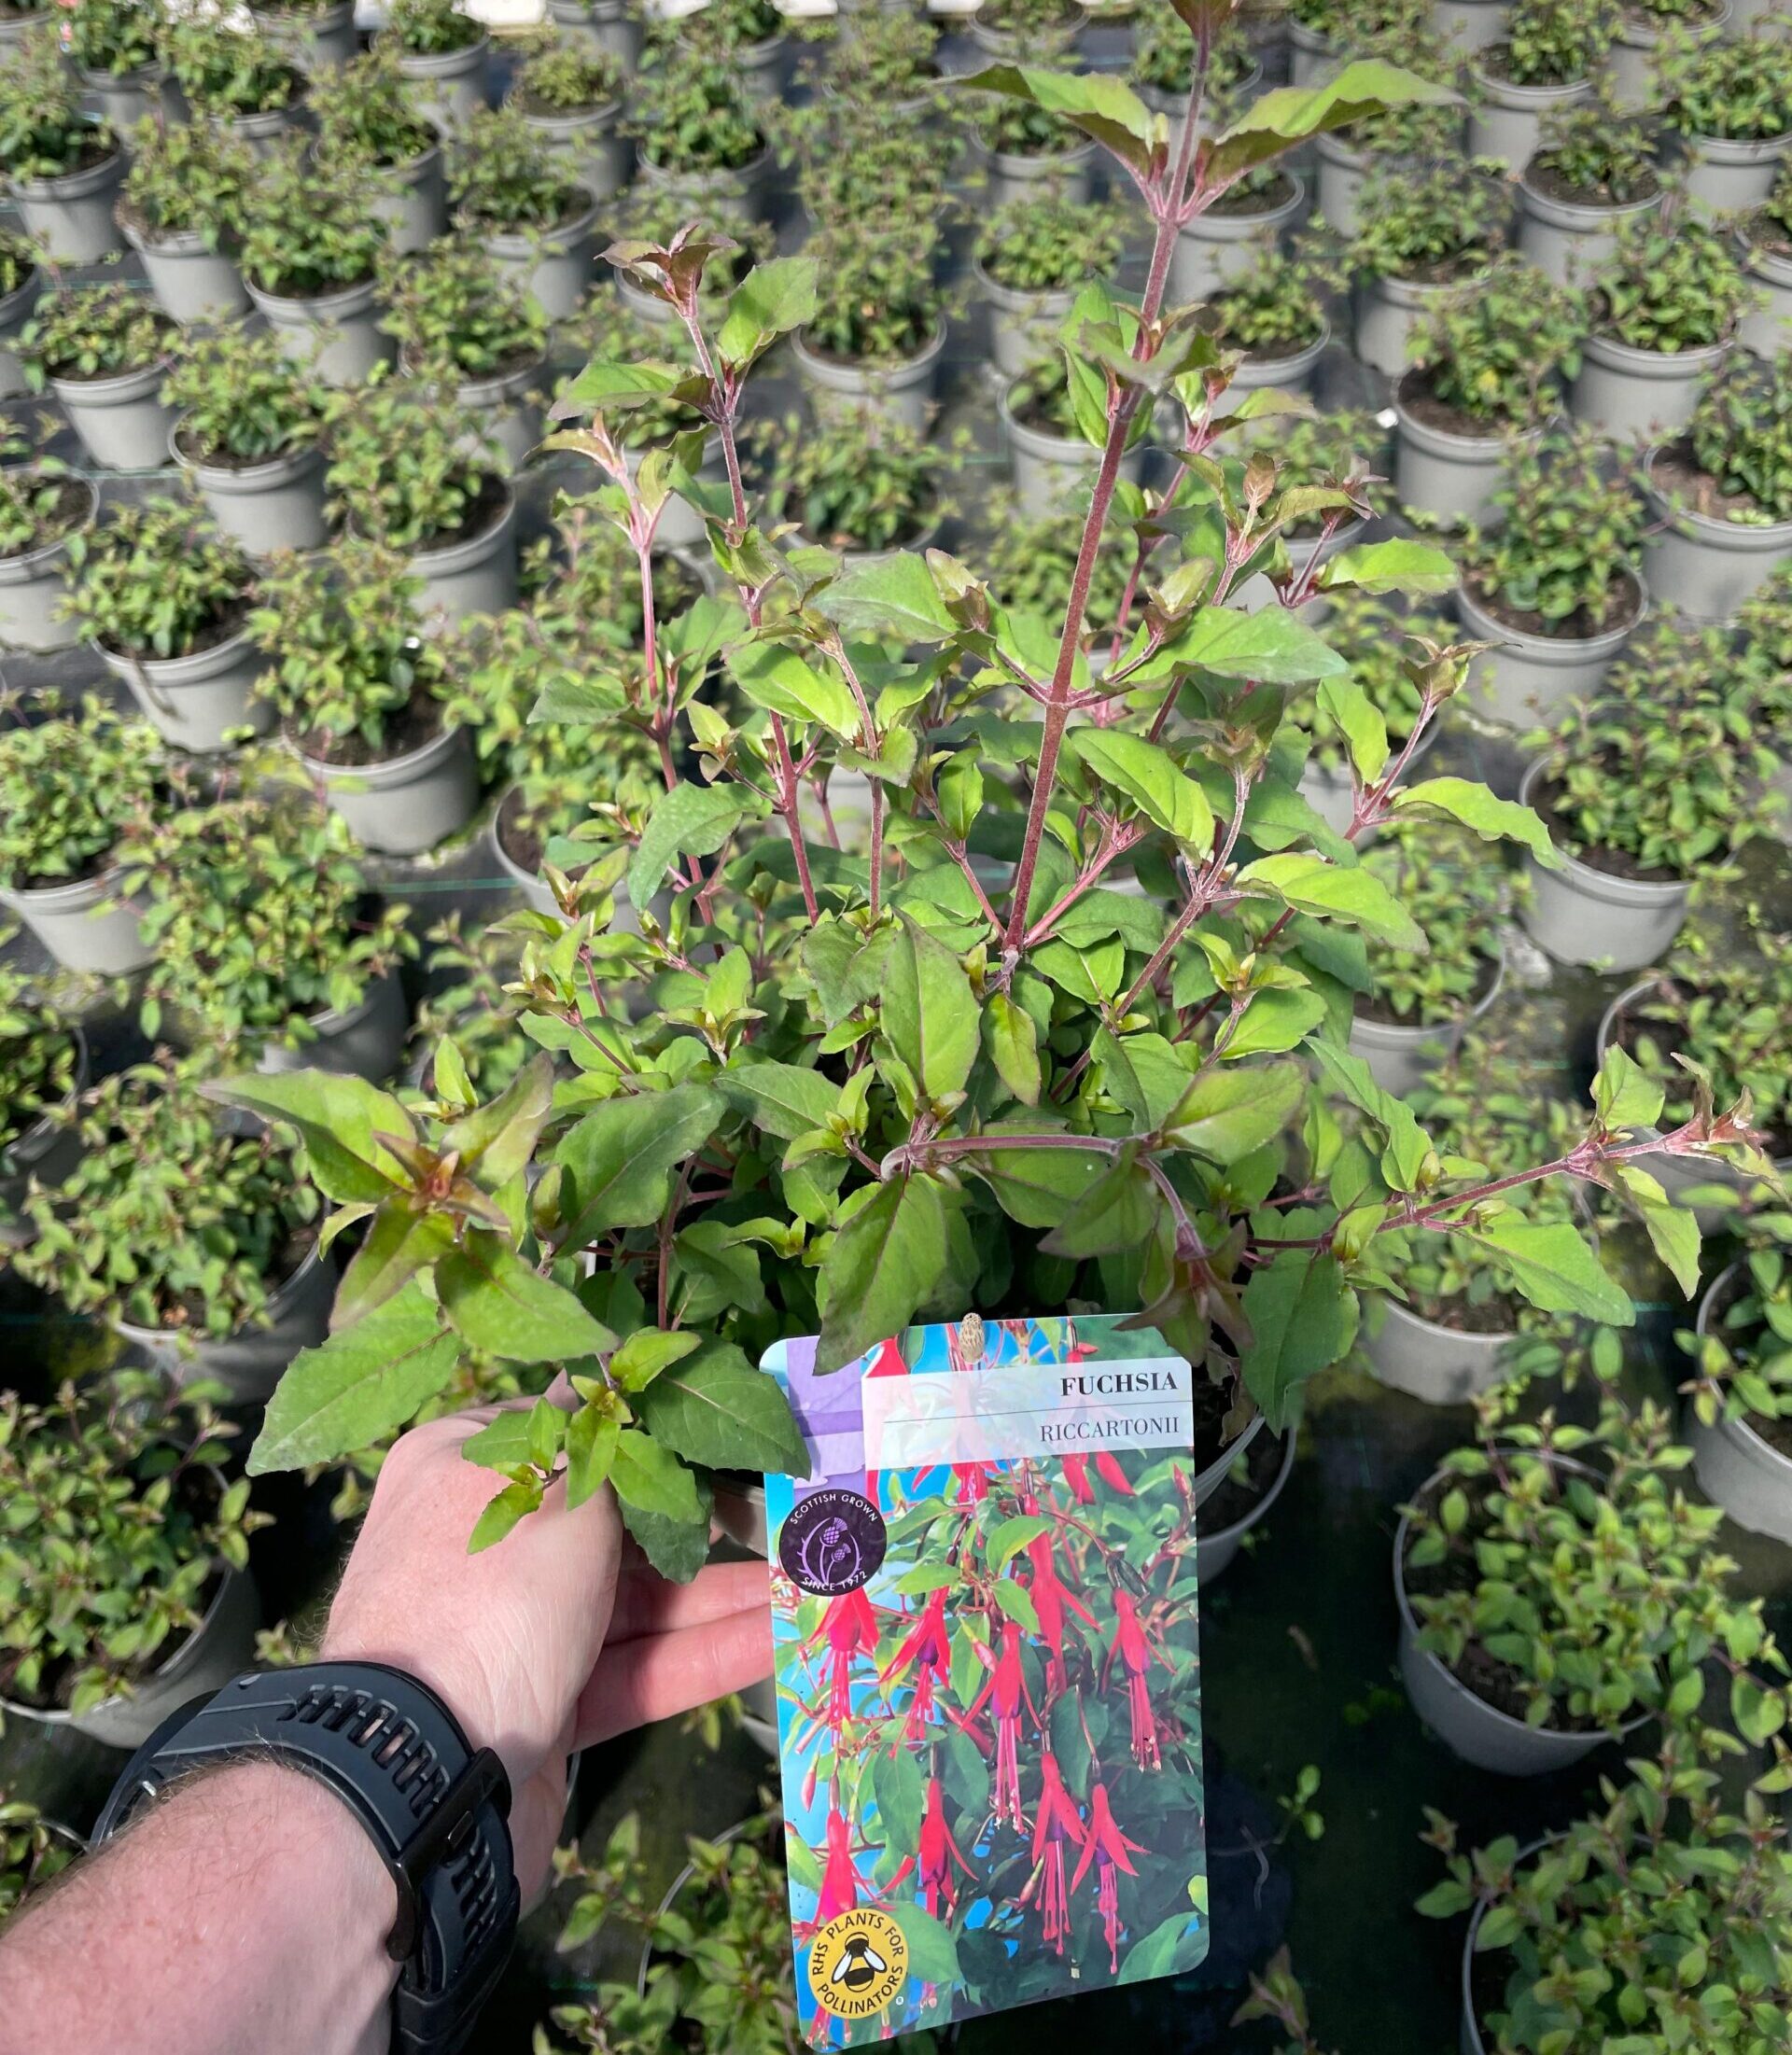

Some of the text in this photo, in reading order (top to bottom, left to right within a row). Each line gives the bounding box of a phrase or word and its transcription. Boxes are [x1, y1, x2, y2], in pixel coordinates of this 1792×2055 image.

[1060, 1372, 1178, 1396] FUCHSIA
[1041, 1416, 1180, 1442] RICCARTONII
[790, 1493, 878, 1525] SCOTTISH GROWN
[802, 1571, 868, 1591] SINCE 1972
[812, 1912, 904, 1976] RHS PLANTS FOR
[817, 1965, 903, 2014] POLLINATORS
